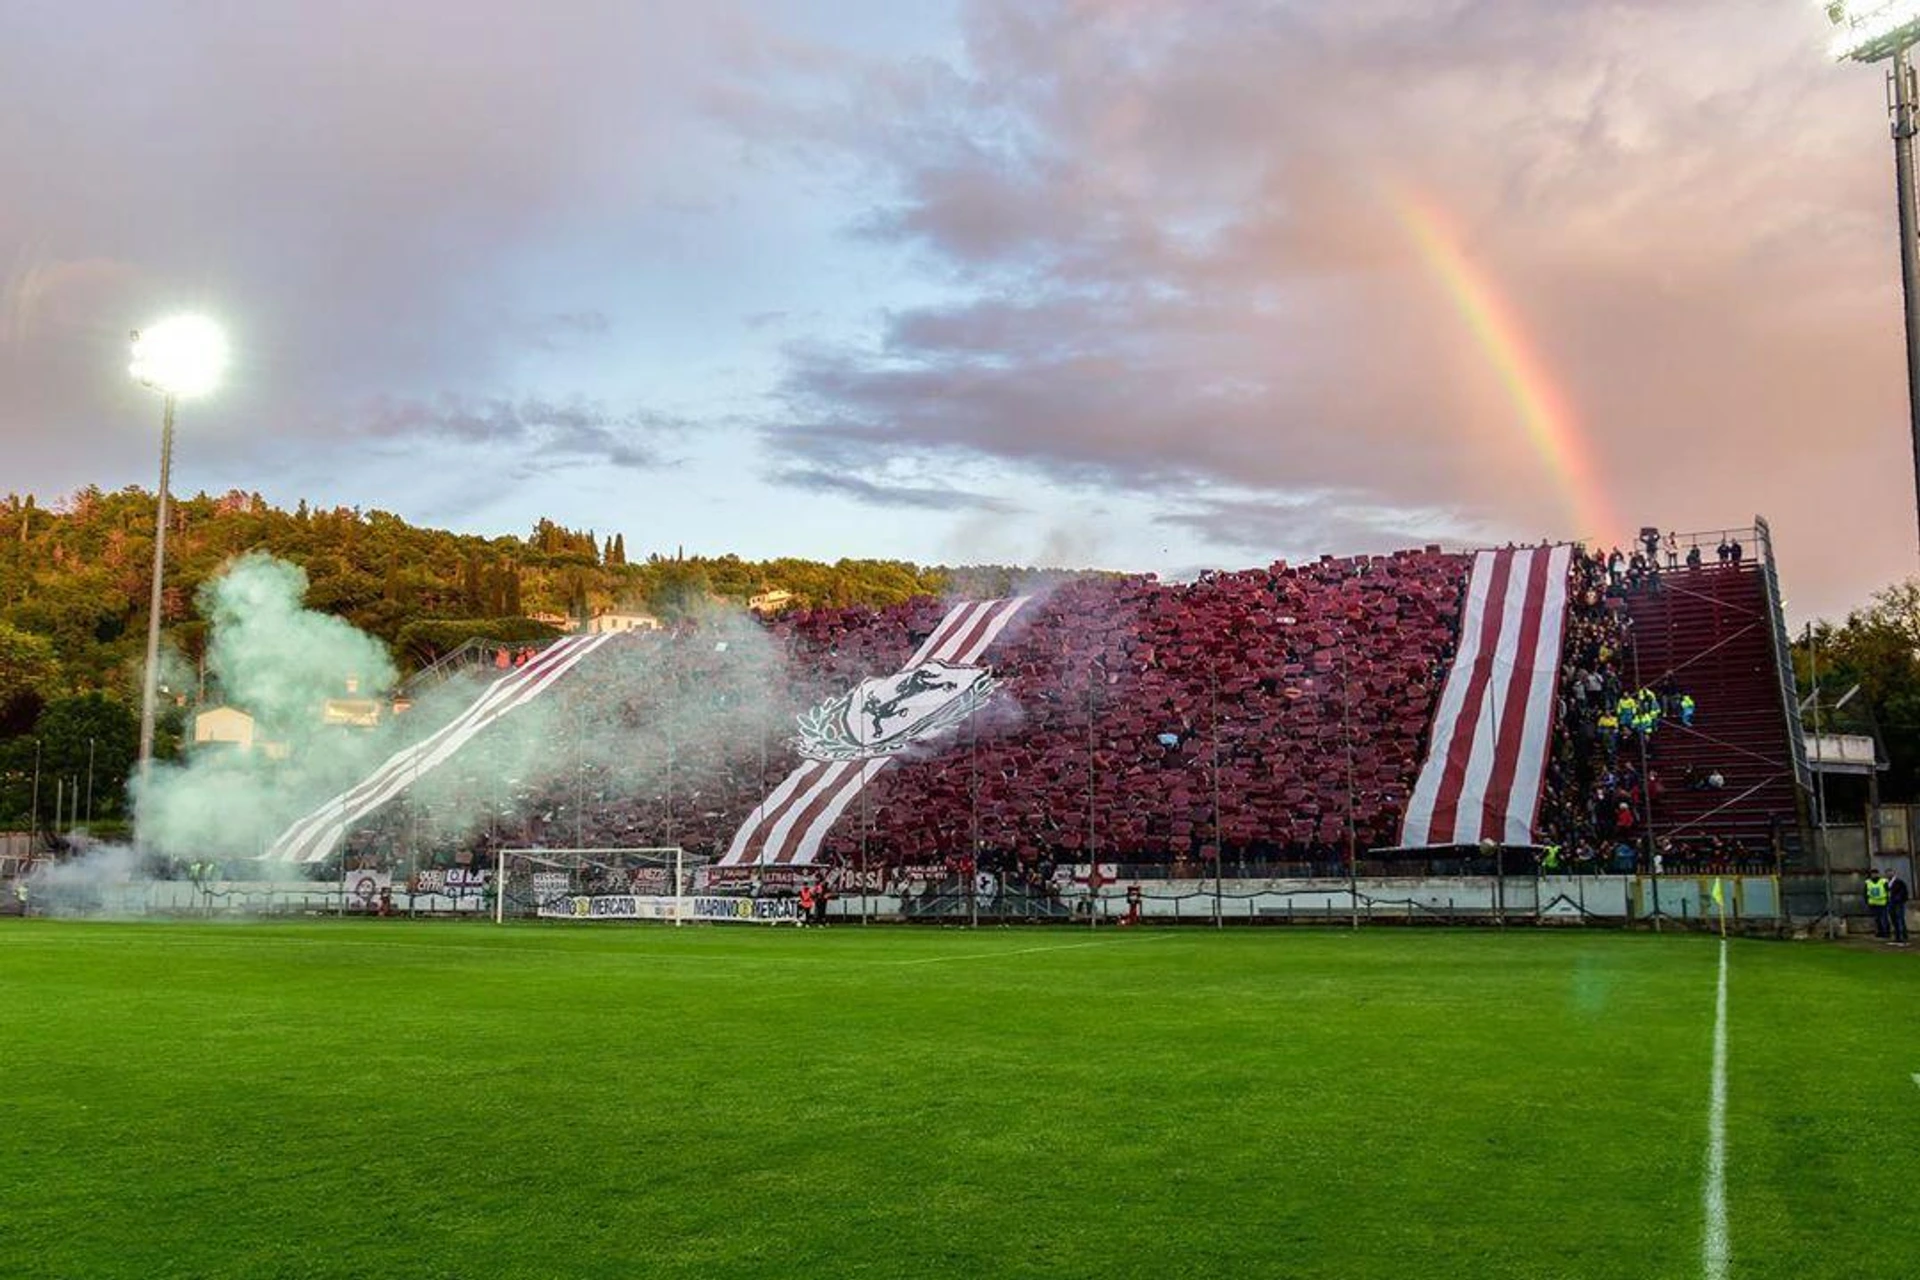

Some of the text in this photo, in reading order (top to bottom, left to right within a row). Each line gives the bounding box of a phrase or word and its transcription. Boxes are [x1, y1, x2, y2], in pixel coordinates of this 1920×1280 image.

[838, 867, 883, 891] FOSSA
[589, 897, 636, 915] MERCATO
[694, 898, 738, 917] MARINO
